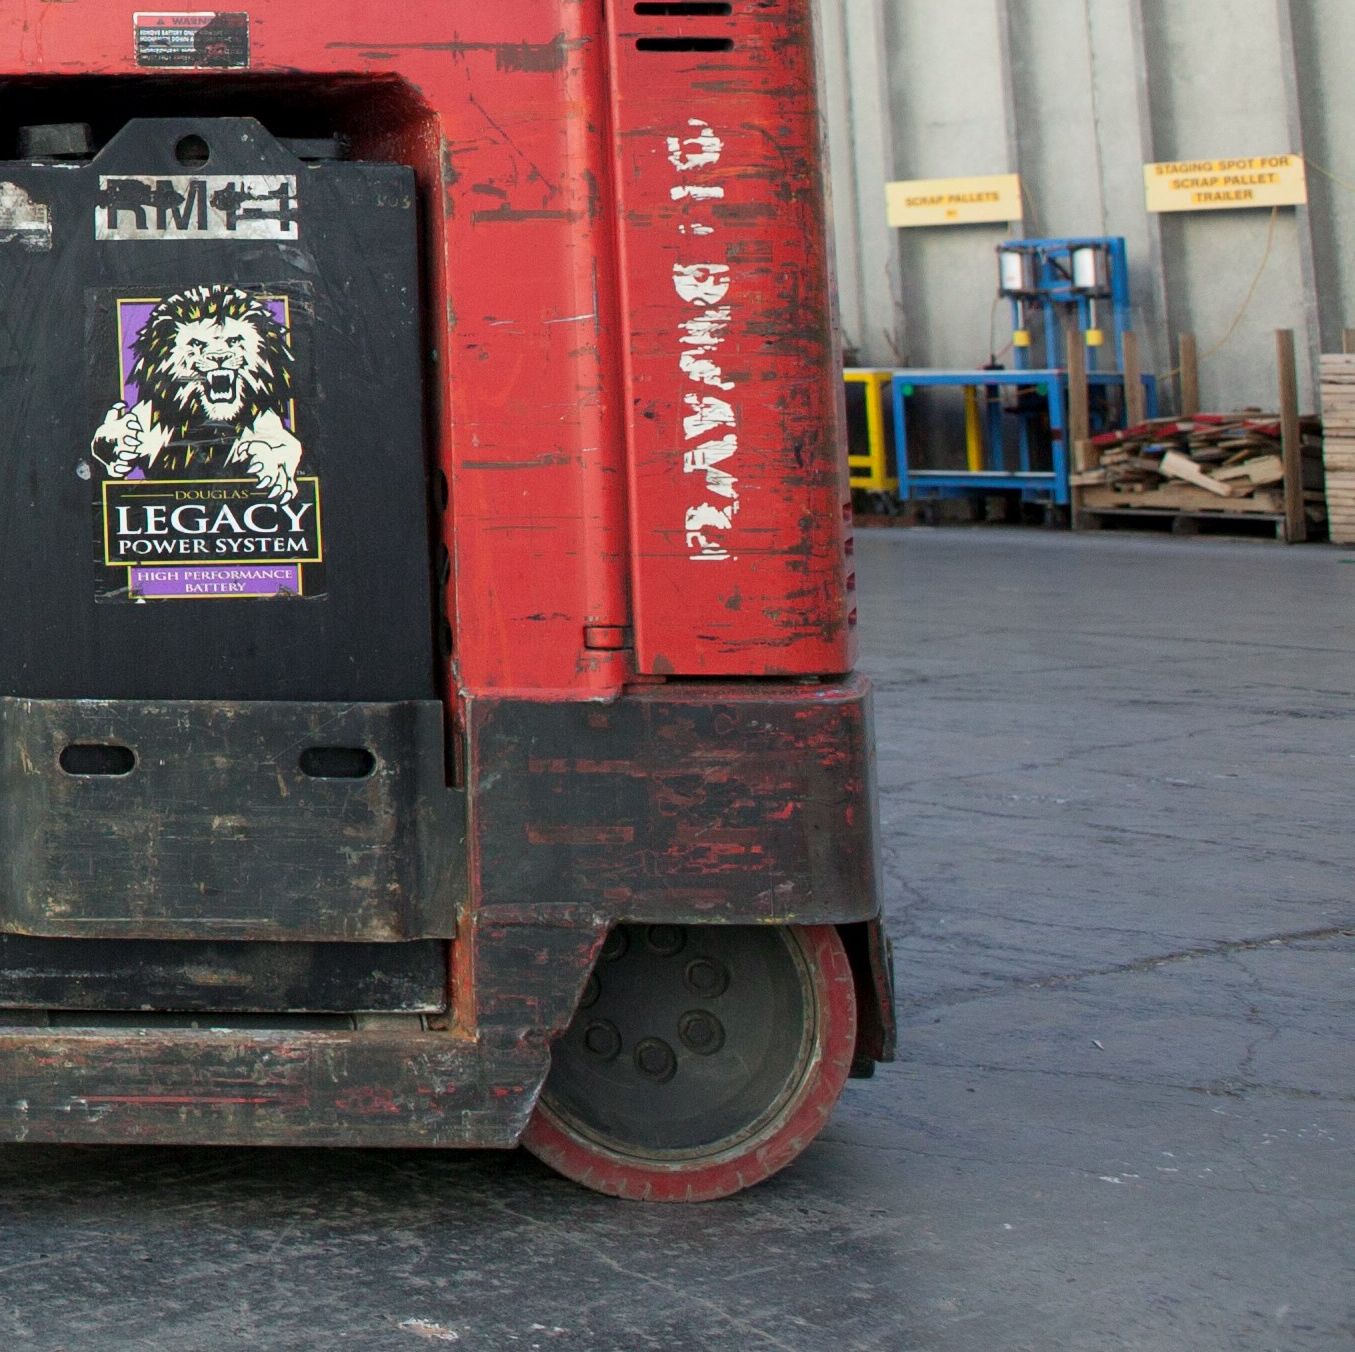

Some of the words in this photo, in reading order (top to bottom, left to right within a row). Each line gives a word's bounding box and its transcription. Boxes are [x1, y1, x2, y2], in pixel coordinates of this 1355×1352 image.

[1155, 160, 1213, 175] STAGING
[1217, 158, 1254, 171] SPOT
[1260, 156, 1290, 168] FOR
[1172, 176, 1219, 189] SCRAP
[1223, 173, 1275, 186] PALLET
[905, 195, 944, 207] SCRAP
[947, 191, 999, 204] PALLETS
[1195, 189, 1253, 203] TRAILER
[175, 489, 249, 500] DOUGLAS
[115, 502, 313, 536] LEGACY
[118, 538, 211, 555] POWER
[215, 536, 309, 554] SYSTEM
[137, 571, 179, 582] HIGH
[184, 569, 293, 581] PERFORMANCE
[185, 582, 246, 593] BATTERY
